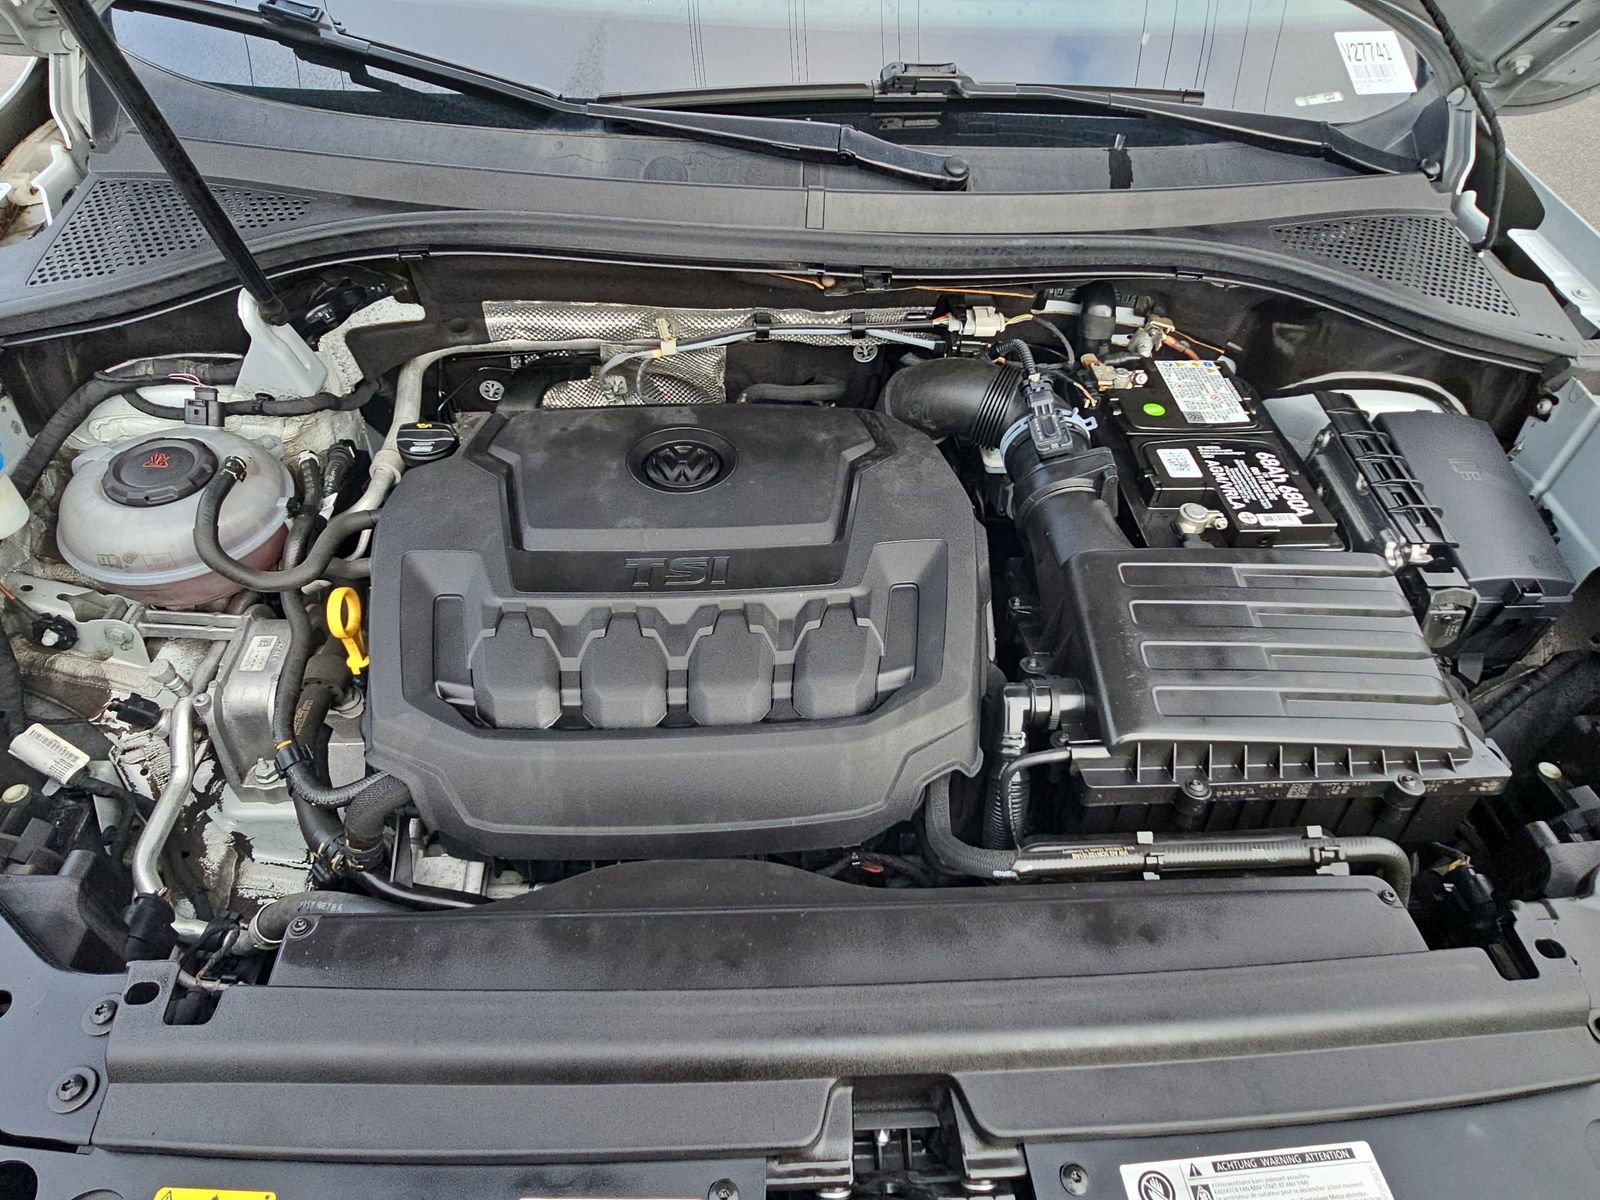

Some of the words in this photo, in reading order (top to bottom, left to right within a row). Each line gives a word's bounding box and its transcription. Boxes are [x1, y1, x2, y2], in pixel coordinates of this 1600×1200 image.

[1340, 42, 1392, 62] V27741
[1204, 459, 1246, 509] AGM/VRLA
[1255, 452, 1290, 483] 68Ah
[1277, 485, 1315, 517] 680A
[625, 555, 731, 587] TSI
[1216, 1158, 1258, 1172] ACHTUNG
[1261, 1154, 1302, 1167] WARNING
[1305, 1149, 1350, 1162] ATTENTION
